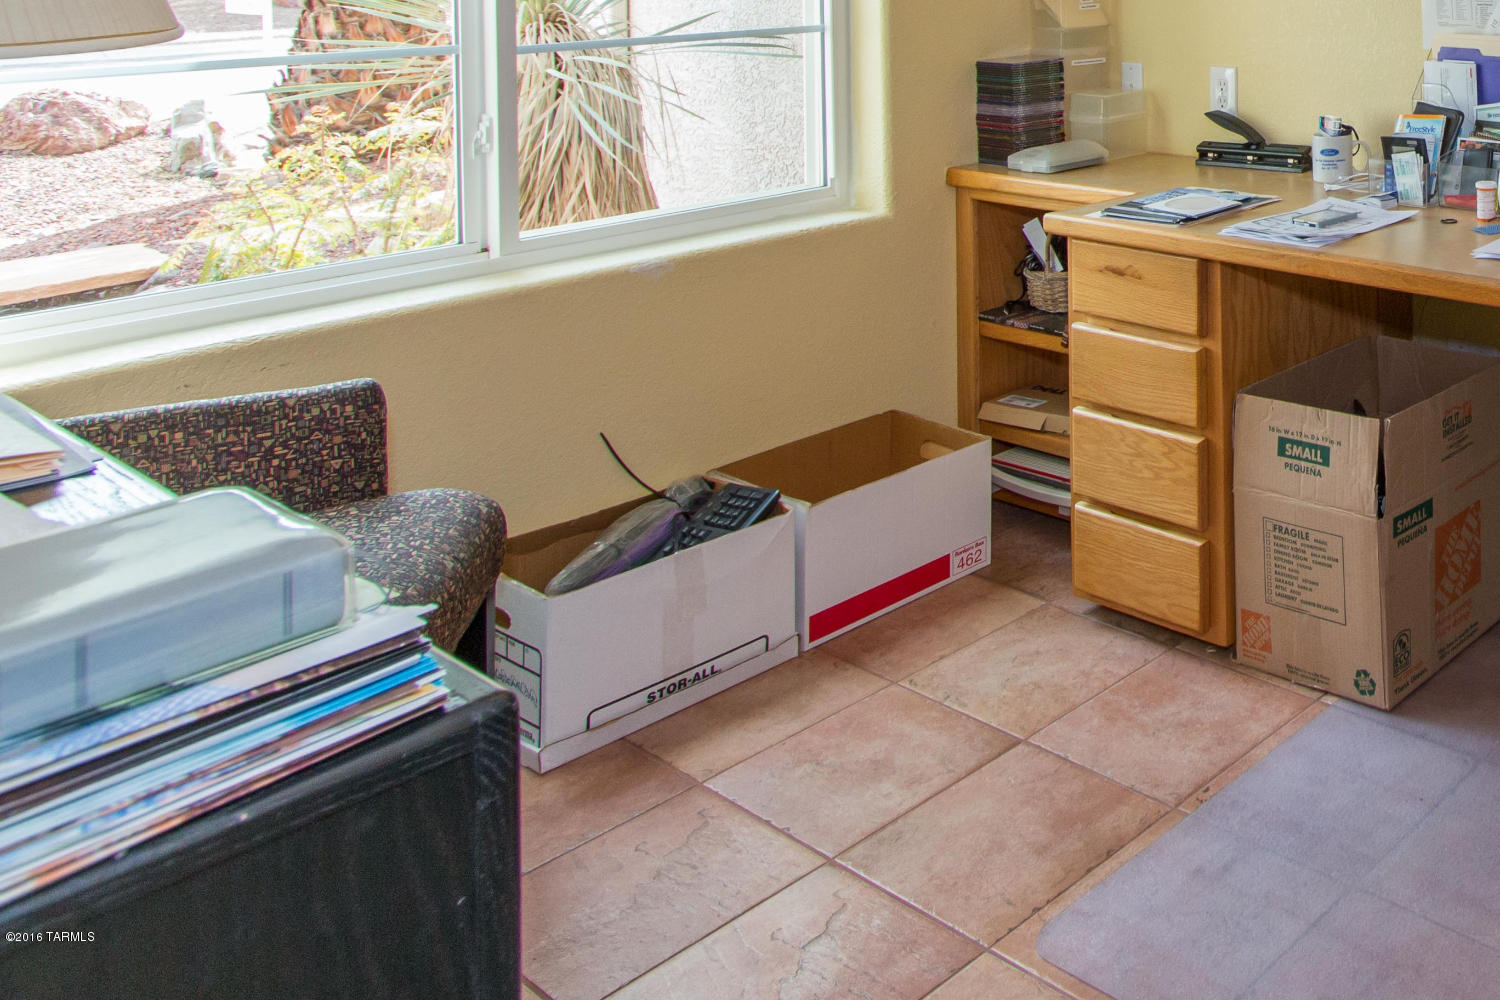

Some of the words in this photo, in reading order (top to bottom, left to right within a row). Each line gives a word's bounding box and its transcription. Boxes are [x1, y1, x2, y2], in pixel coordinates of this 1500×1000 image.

[1284, 443, 1323, 463] SMALL
[1396, 507, 1428, 534] SMALL
[1272, 523, 1309, 540] FRAGILE
[957, 549, 982, 569] 462
[646, 664, 719, 703] STOR-ALL
